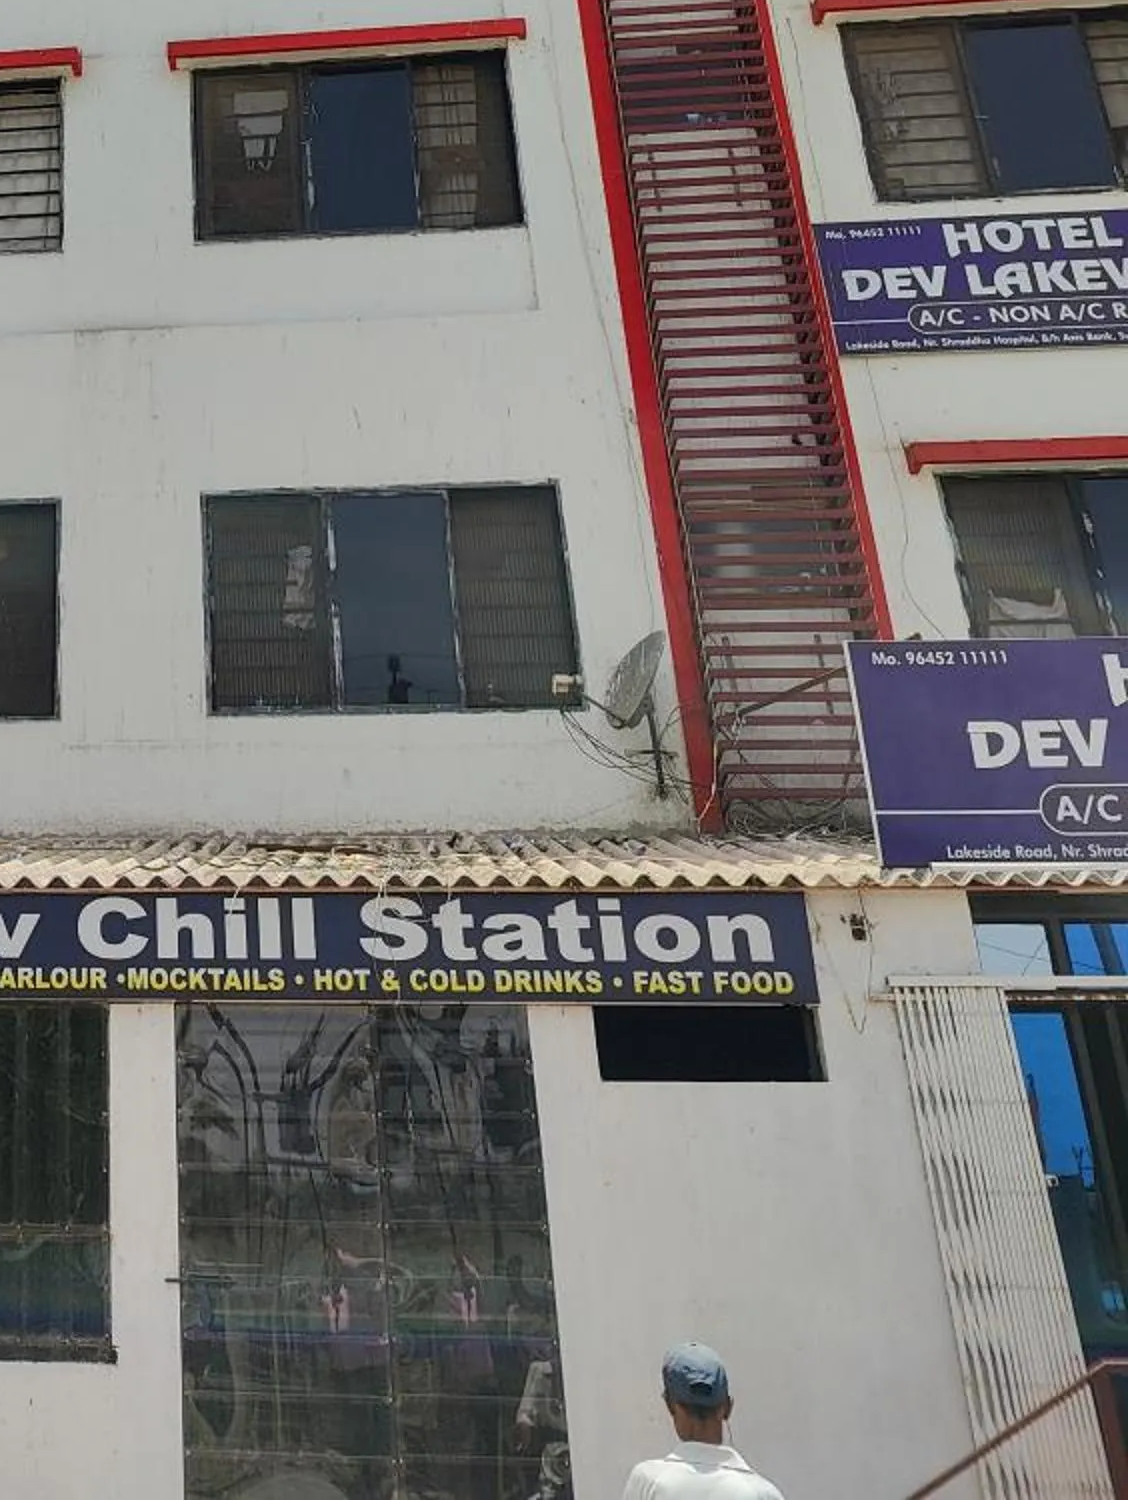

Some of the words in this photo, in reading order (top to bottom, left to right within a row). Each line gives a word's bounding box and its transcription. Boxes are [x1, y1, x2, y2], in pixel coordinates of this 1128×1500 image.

[941, 215, 1124, 258] HOTEL
[841, 265, 947, 301] DEV
[919, 307, 966, 327] A/C
[988, 304, 1052, 323] NON
[1059, 303, 1105, 322] A/C
[872, 651, 902, 665] Mo.
[905, 650, 955, 665] 96452
[960, 650, 1008, 665] 11111
[966, 719, 1109, 769] DEV
[1056, 794, 1122, 825] A/C
[947, 843, 1011, 859] Lakeside
[1015, 843, 1058, 860] Road,
[1061, 843, 1084, 858] Nr.
[76, 896, 318, 961] Chill
[359, 896, 776, 963] Station
[313, 968, 371, 991] HOT
[380, 968, 400, 992] &
[408, 968, 485, 993] COLD
[494, 969, 603, 994] DRINKS
[632, 970, 704, 995] FAST
[714, 970, 795, 995] FOOD
